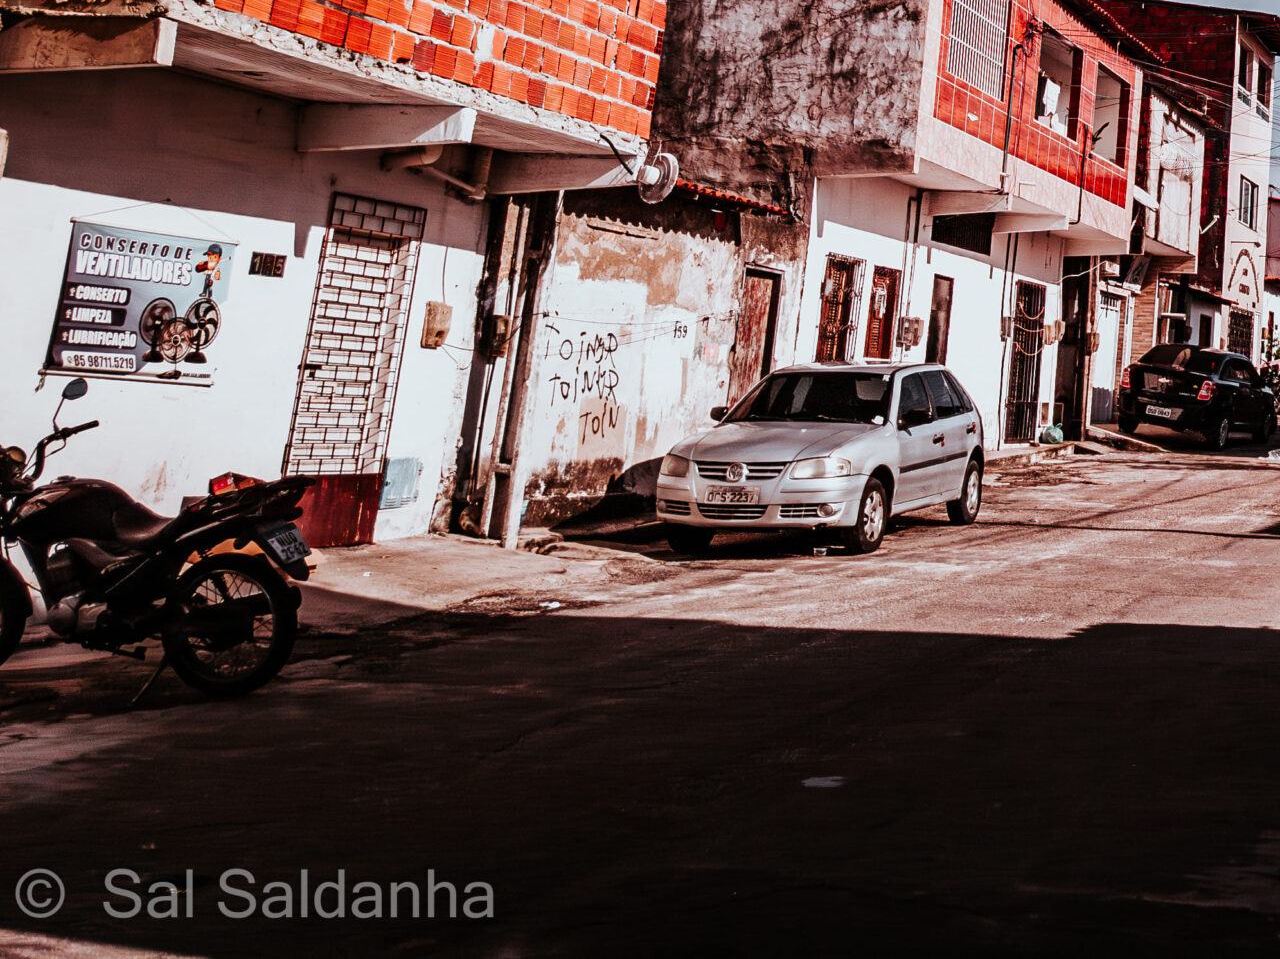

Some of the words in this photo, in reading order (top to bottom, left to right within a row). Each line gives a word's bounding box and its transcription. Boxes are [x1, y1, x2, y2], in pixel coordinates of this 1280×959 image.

[80, 233, 171, 258] CONSERTO
[174, 247, 193, 260] DE
[75, 249, 193, 286] VENTILADORES
[74, 285, 128, 304] CONSERTO
[70, 307, 112, 324] LIMPEZA
[67, 329, 137, 349] LUBRIFICAÇÃO
[73, 354, 88, 367] 85
[88, 355, 135, 370] 98711.5219
